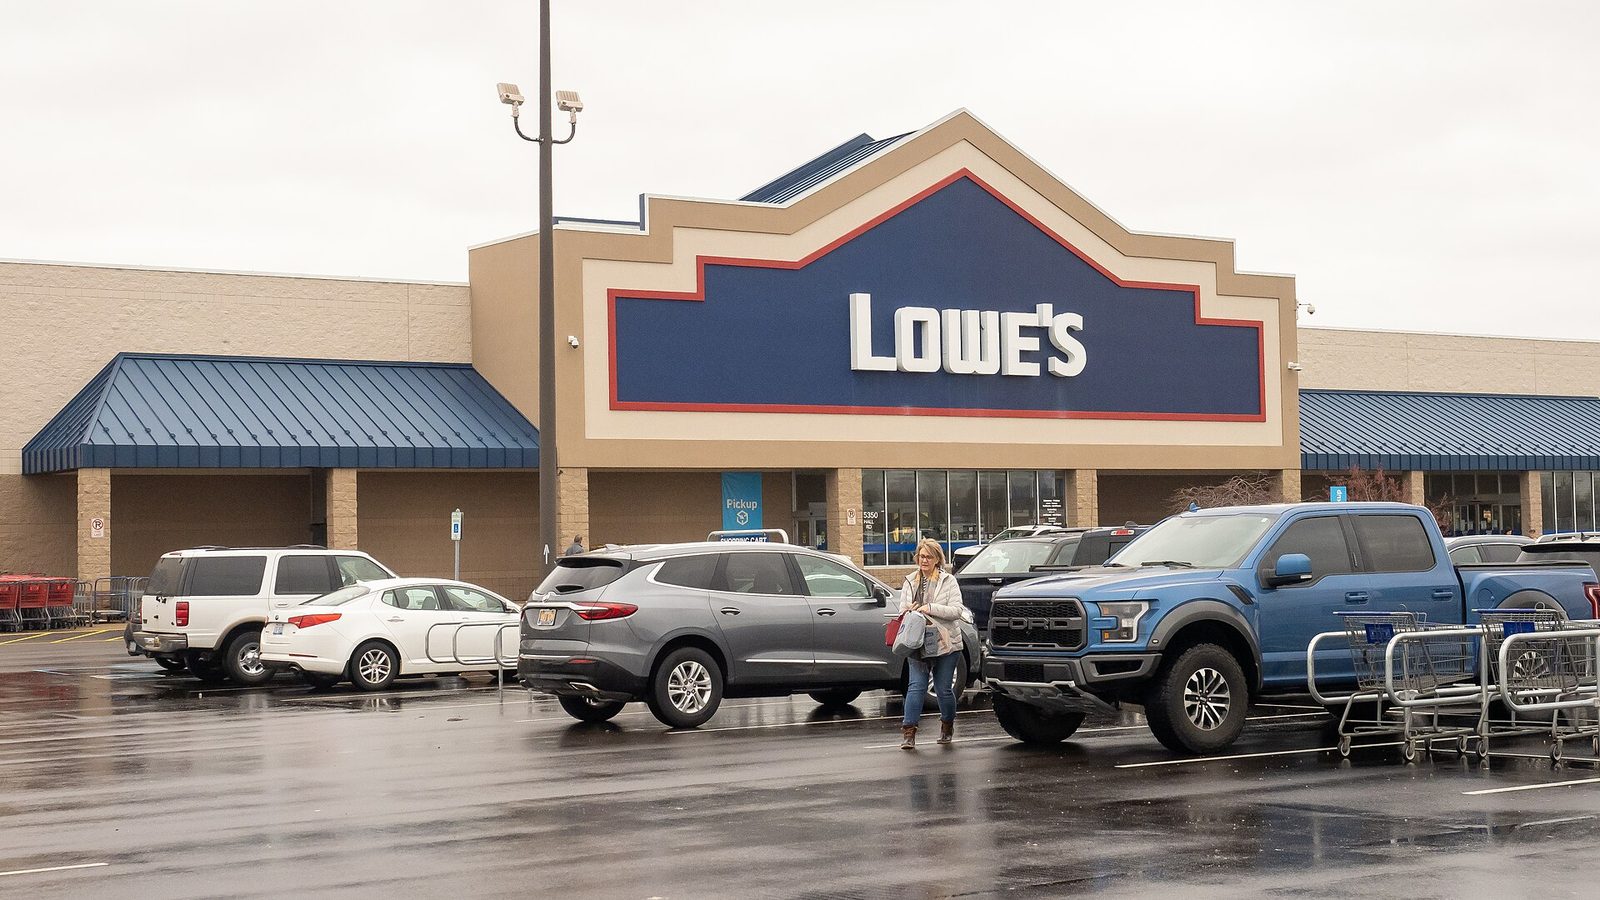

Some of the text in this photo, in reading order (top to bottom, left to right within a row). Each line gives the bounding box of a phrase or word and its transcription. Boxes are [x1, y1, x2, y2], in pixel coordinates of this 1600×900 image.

[849, 293, 1087, 377] LOWE'S
[726, 499, 757, 511] Pickup
[863, 511, 879, 519] 5350
[991, 616, 1071, 630] FORD
